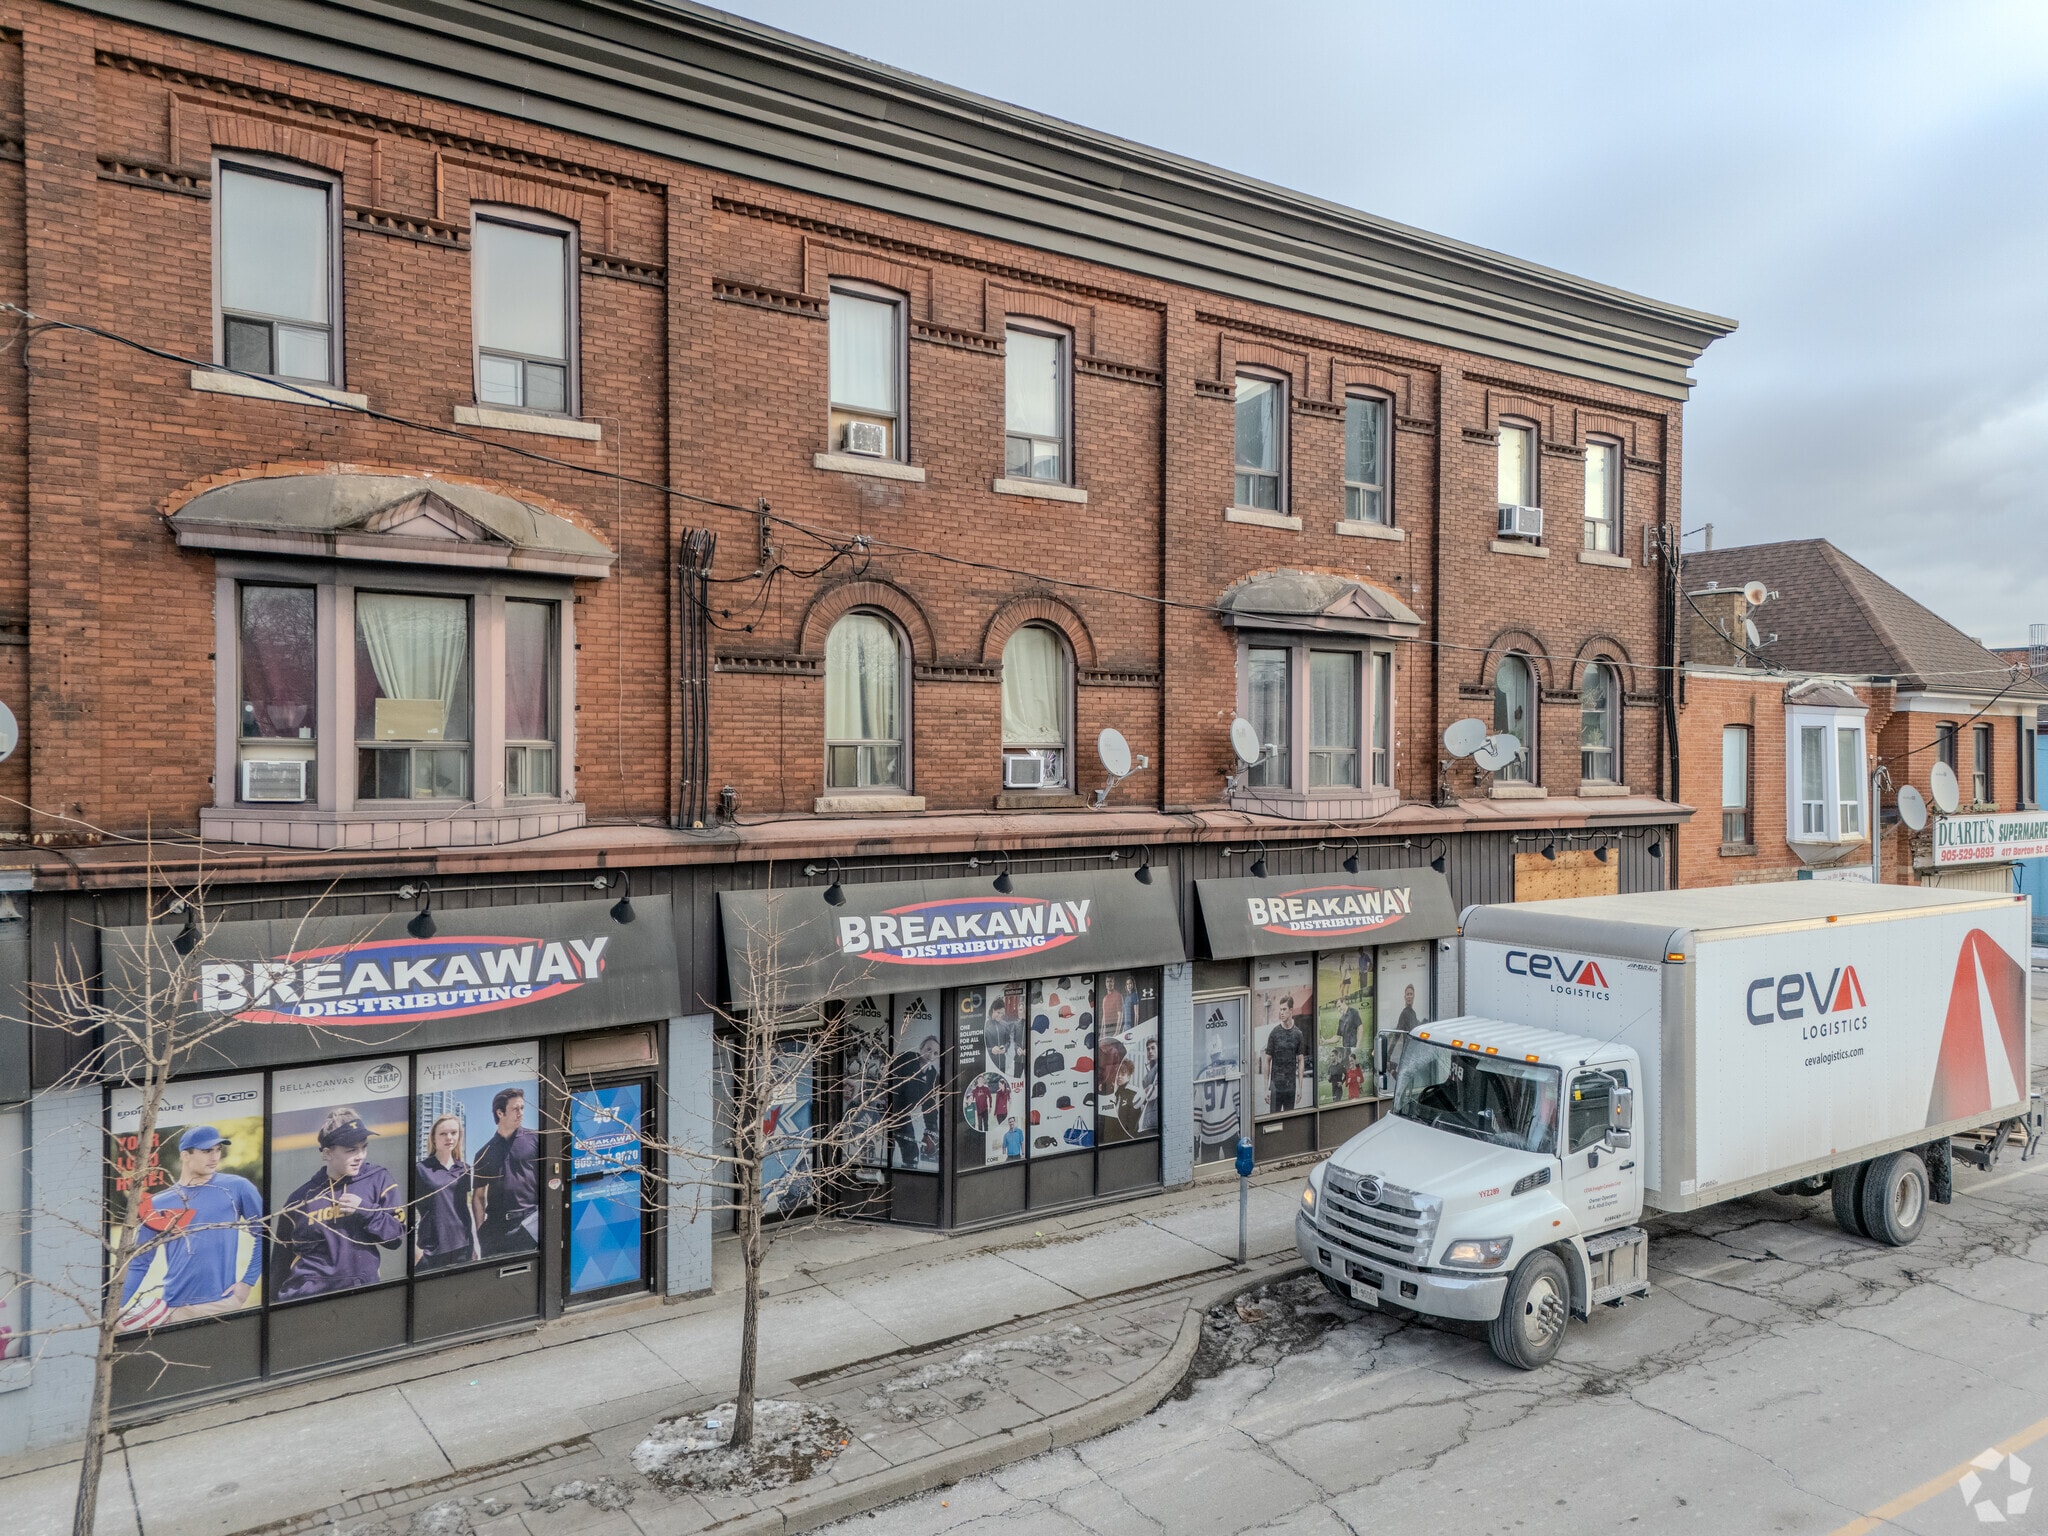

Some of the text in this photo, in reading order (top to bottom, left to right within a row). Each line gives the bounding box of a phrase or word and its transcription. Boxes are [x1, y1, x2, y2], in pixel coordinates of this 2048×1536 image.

[1938, 817, 1995, 846] DUARTE'S
[1941, 846, 1995, 862] 905-529-0893
[2001, 848, 2012, 857] 417
[1248, 887, 1412, 926] BREAKAWAY
[838, 899, 1092, 954] BREAKAWAY
[1290, 915, 1385, 931] DISTRIBUTING
[901, 935, 1046, 959] DISTRIBUTING
[200, 936, 609, 1013] BREAKAWAY
[1551, 984, 1610, 1001] LOGISTICS
[298, 984, 533, 1018] DISTRIBUTING
[1205, 1019, 1228, 1030] adidas
[1803, 1016, 1868, 1040] LOGISTICS
[960, 1029, 984, 1038] SOLUTION
[960, 1049, 981, 1058] APPAREL
[960, 1057, 976, 1065] NEEDS
[1804, 1047, 1864, 1067] cevalogistics.com
[423, 1060, 477, 1076] AUTHENTIC
[485, 1057, 533, 1069] FLEXFIT
[367, 1073, 399, 1085] RED KAP
[432, 1066, 483, 1081] HEADWEAR
[1010, 1080, 1025, 1089] TEAM
[215, 1090, 258, 1104] OGIO
[1203, 1080, 1229, 1113] 97
[117, 1133, 160, 1152] YOR
[117, 1153, 160, 1172] LOO
